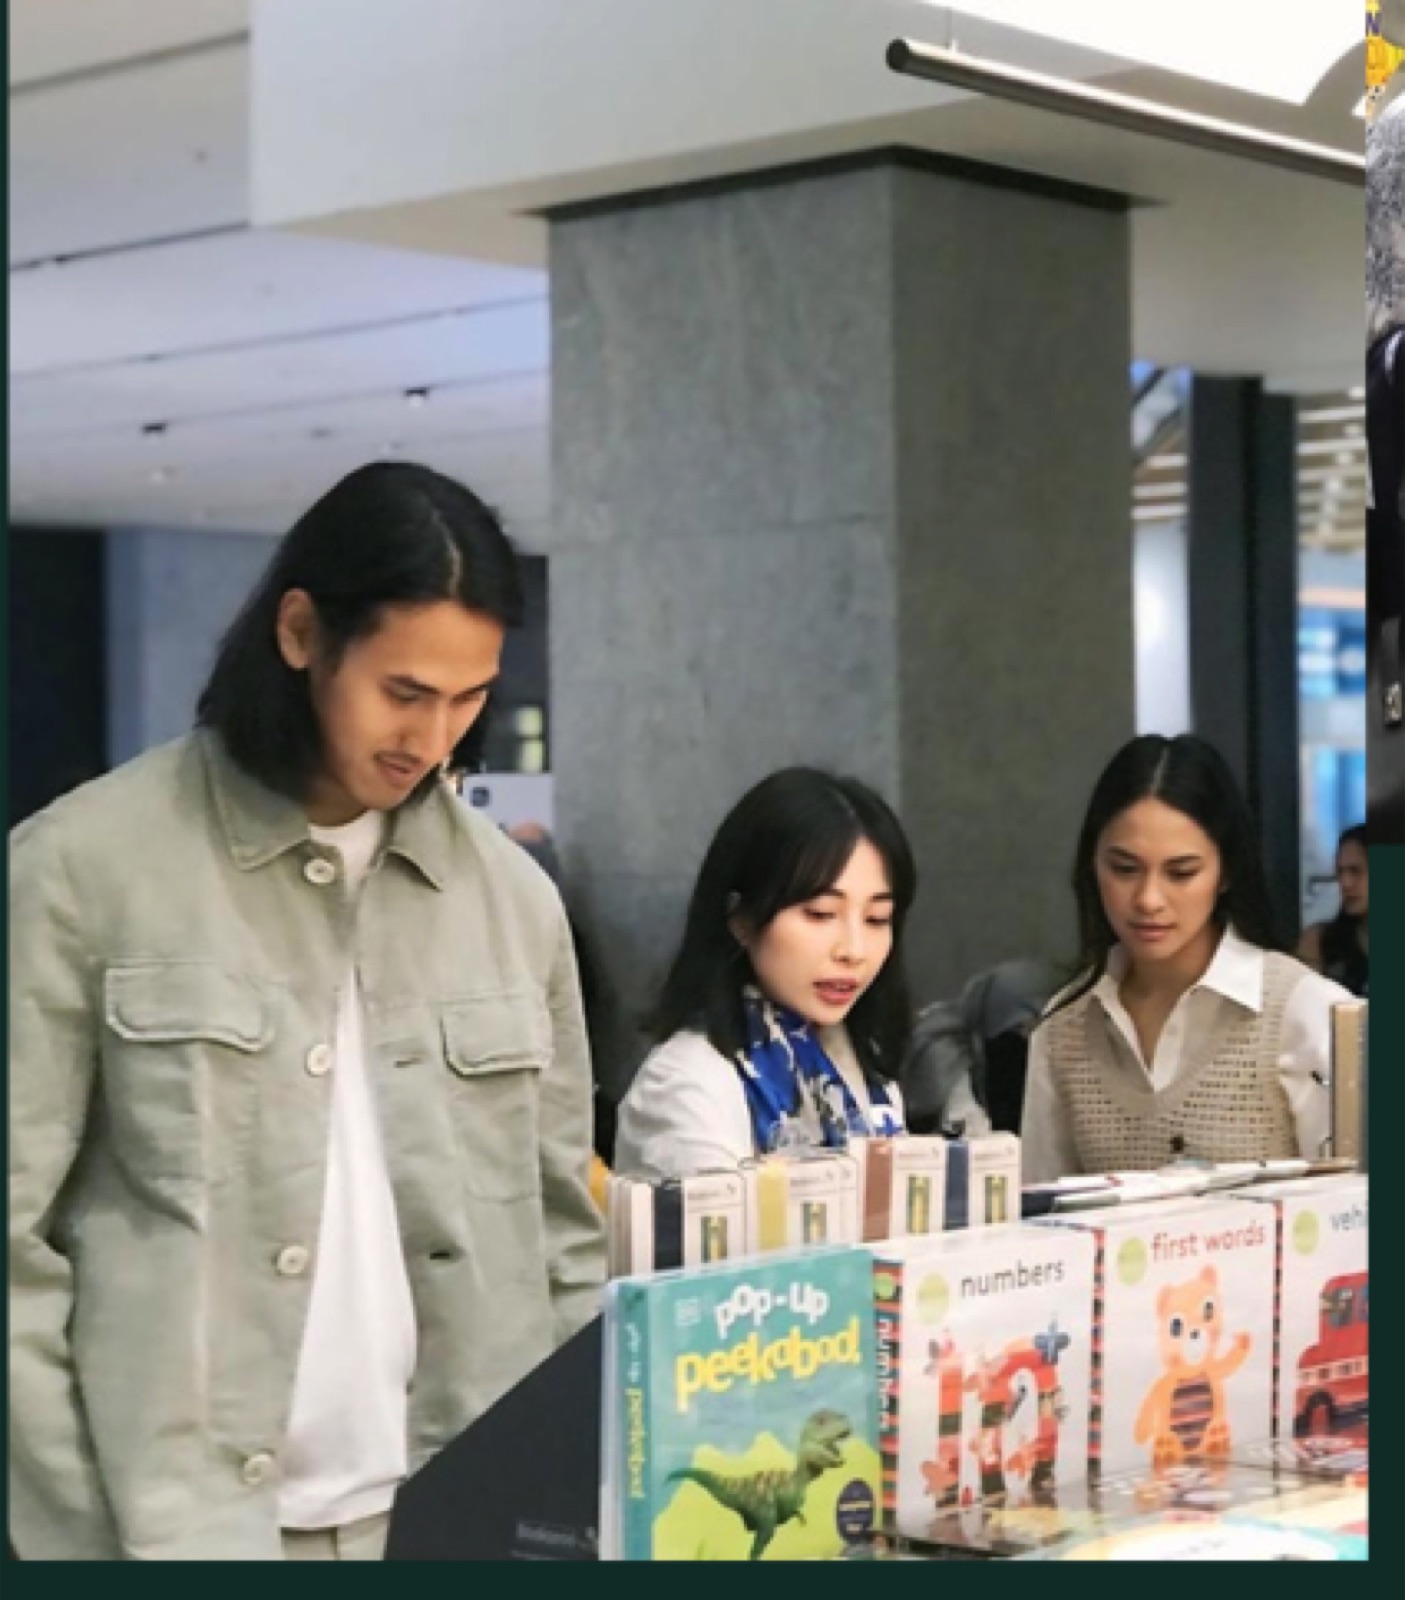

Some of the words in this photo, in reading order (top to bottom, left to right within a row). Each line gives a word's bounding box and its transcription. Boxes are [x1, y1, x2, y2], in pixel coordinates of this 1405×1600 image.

[1152, 1232, 1198, 1262] first
[1203, 1220, 1266, 1251] words
[960, 1257, 1065, 1298] numbers
